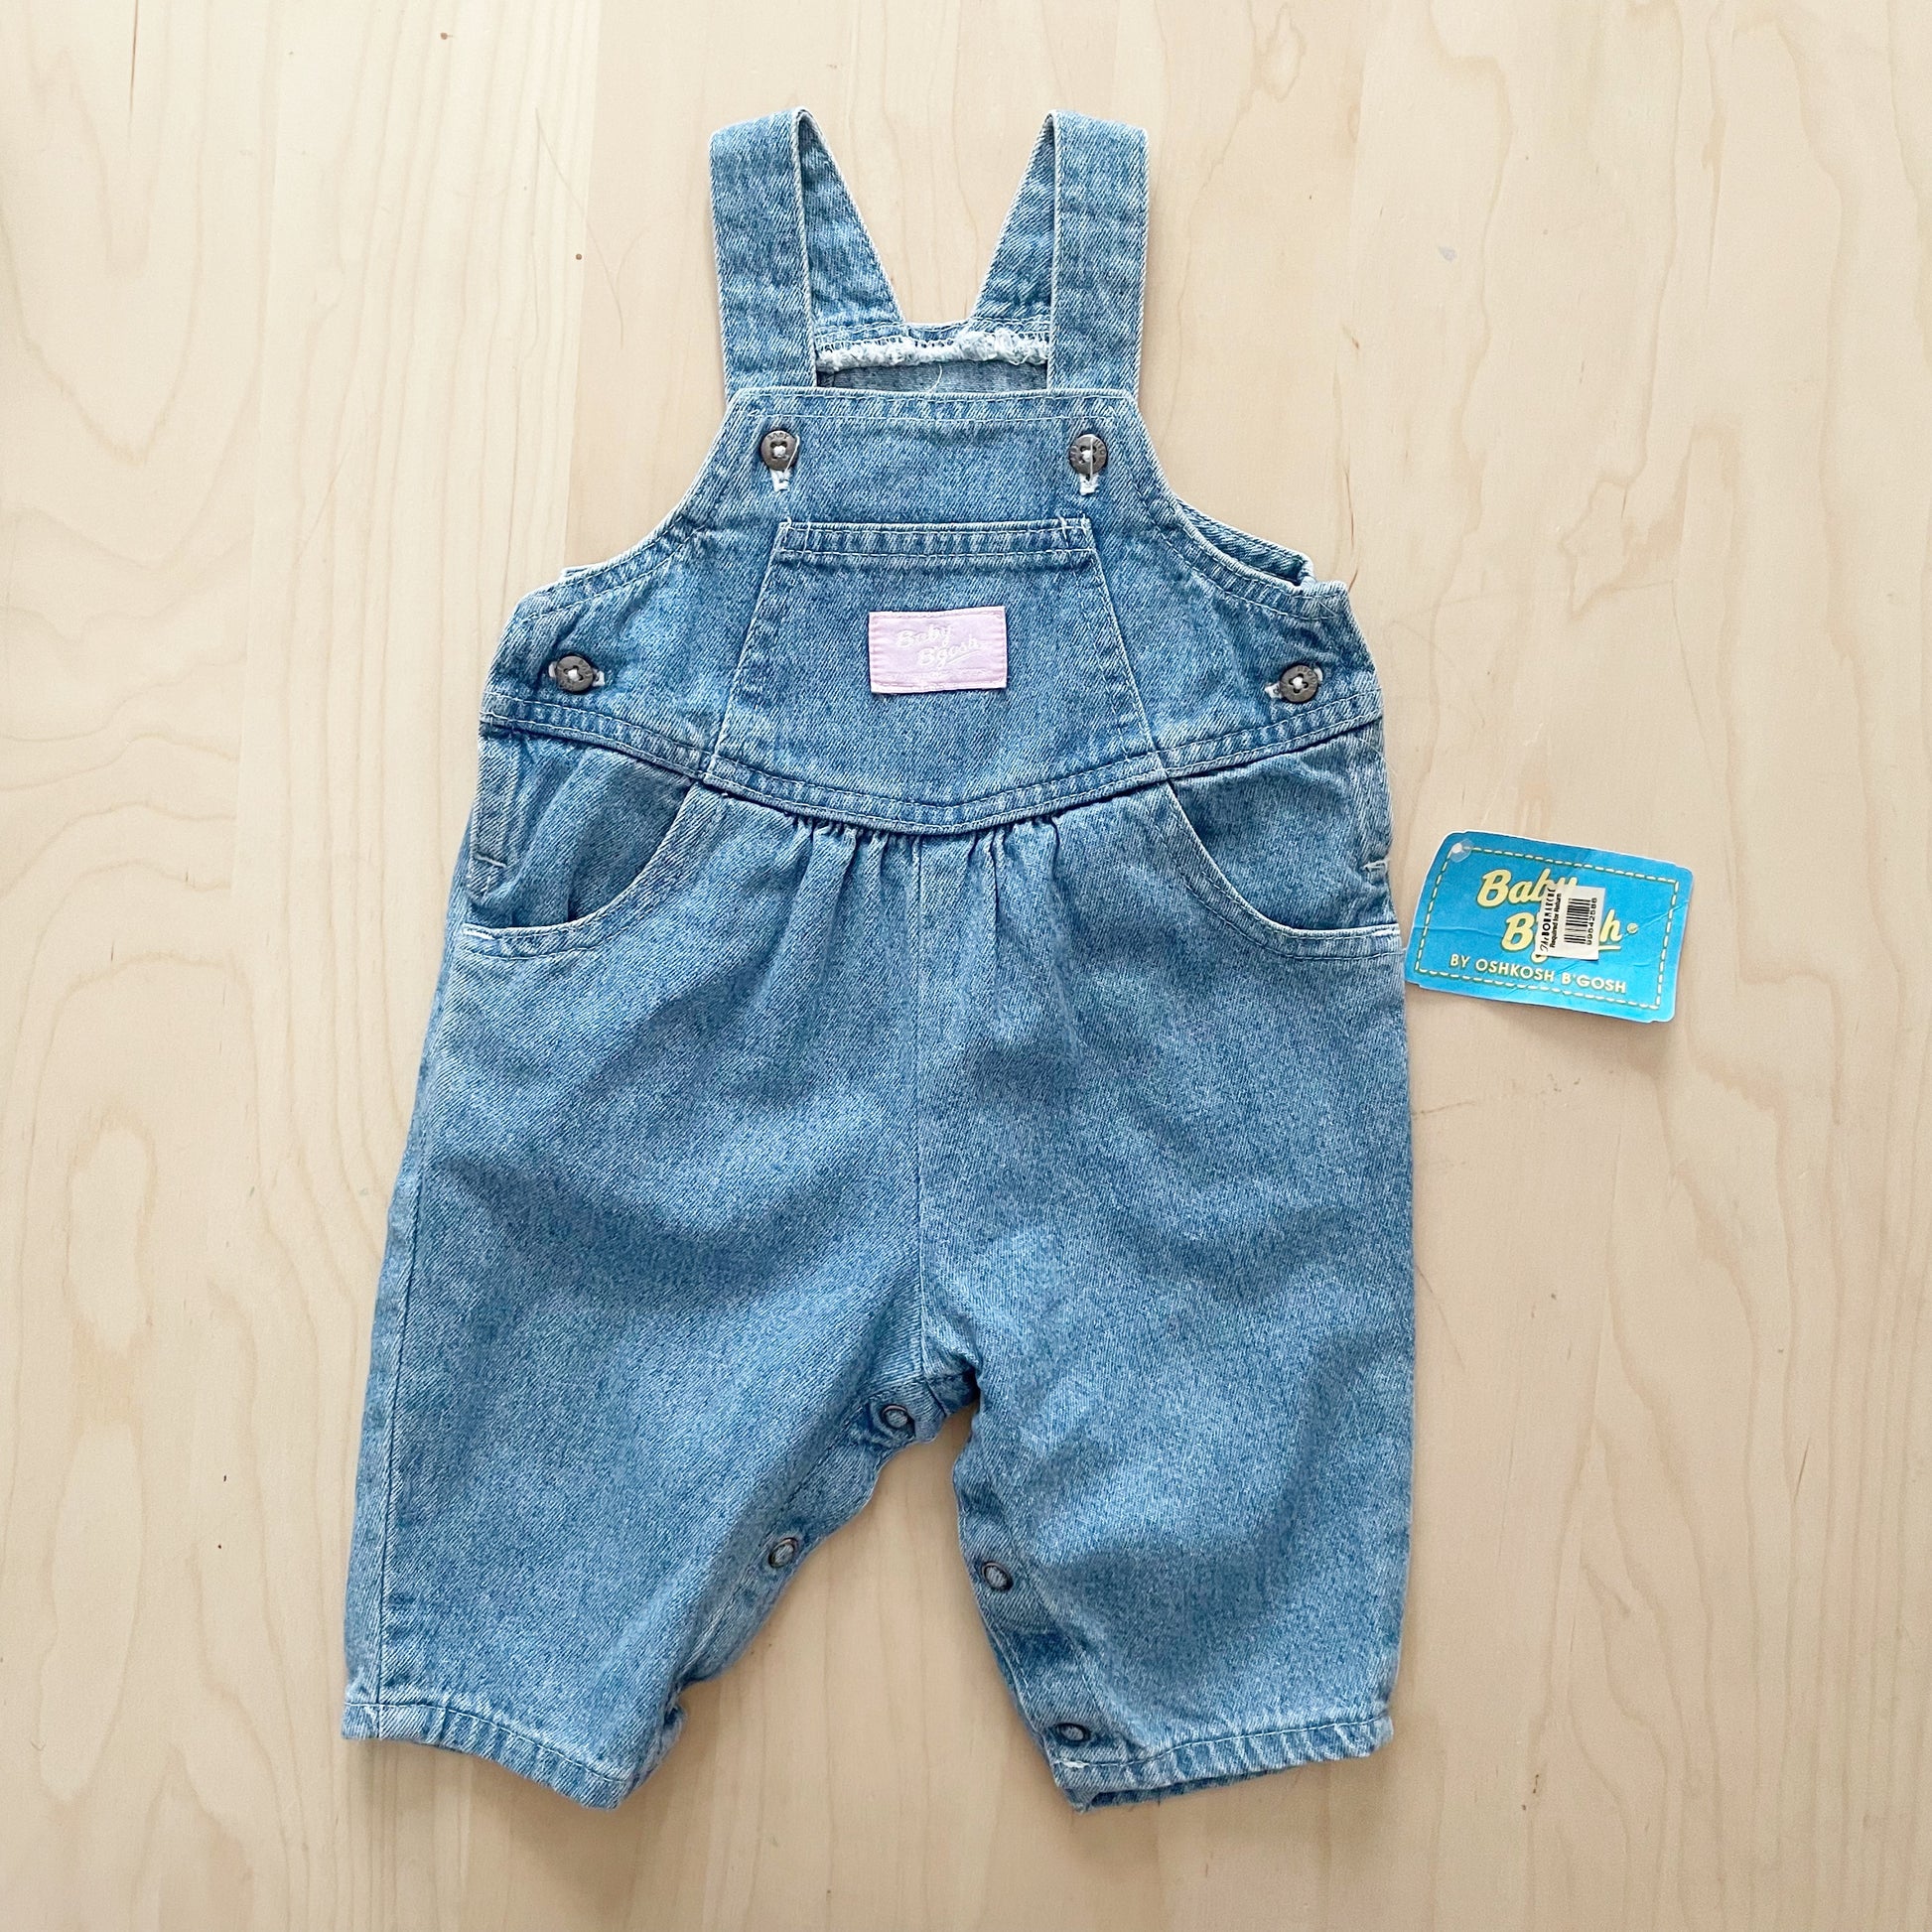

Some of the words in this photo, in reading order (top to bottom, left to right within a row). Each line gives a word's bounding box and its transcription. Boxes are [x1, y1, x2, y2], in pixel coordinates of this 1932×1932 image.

[896, 623, 953, 648] Baby
[1477, 868, 1578, 906] Bab
[1549, 921, 1559, 948] Required
[1449, 953, 1470, 968] BY
[1475, 958, 1556, 983] OSHKOSH
[1561, 972, 1626, 994] B'GOSH
